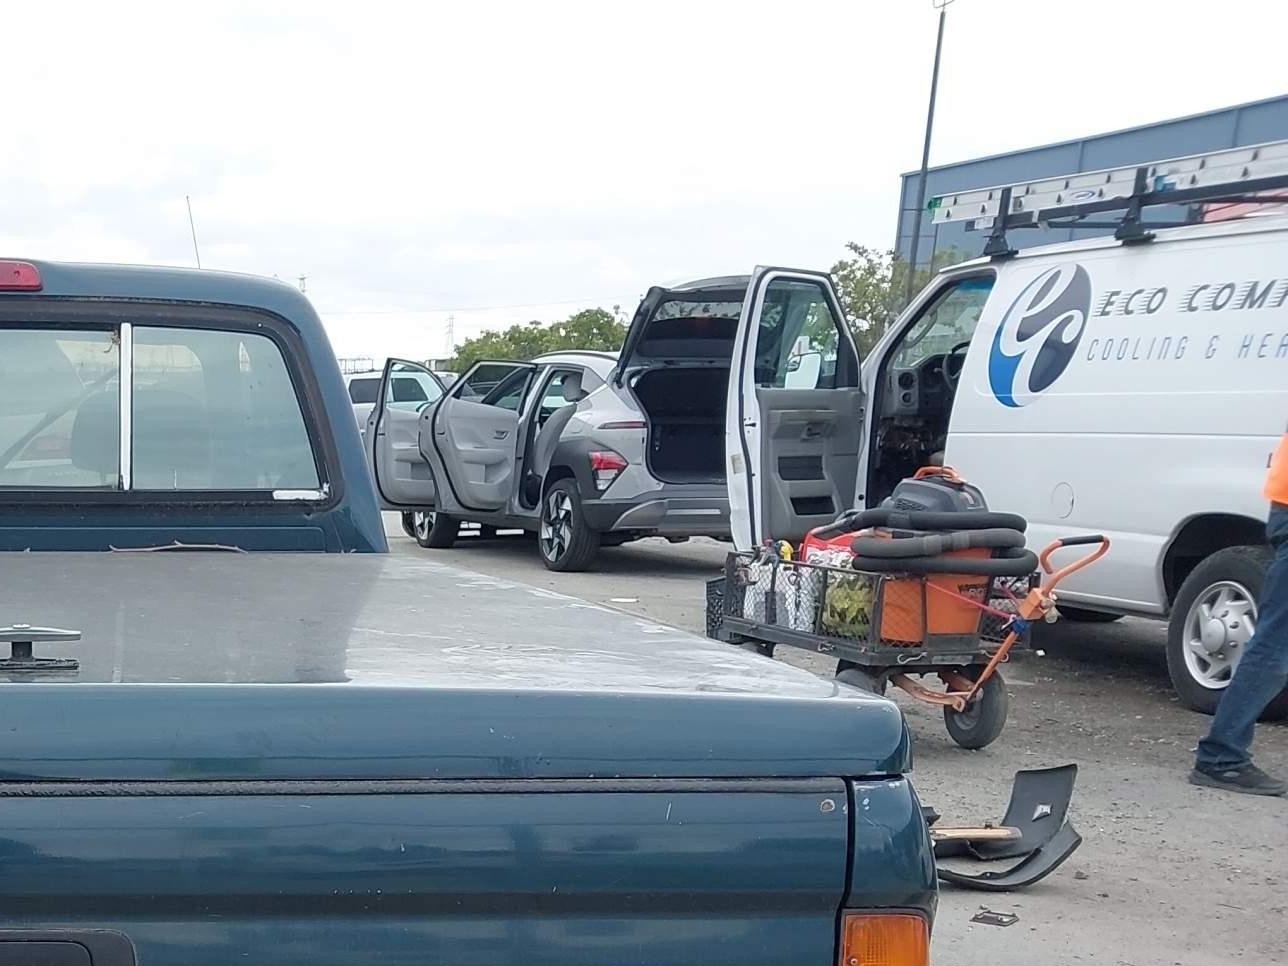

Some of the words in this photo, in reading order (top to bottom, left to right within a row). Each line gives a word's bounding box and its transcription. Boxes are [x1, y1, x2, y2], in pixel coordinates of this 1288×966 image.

[1092, 286, 1168, 317] ECO
[1086, 336, 1189, 361] COOLING
[1204, 334, 1221, 359] &
